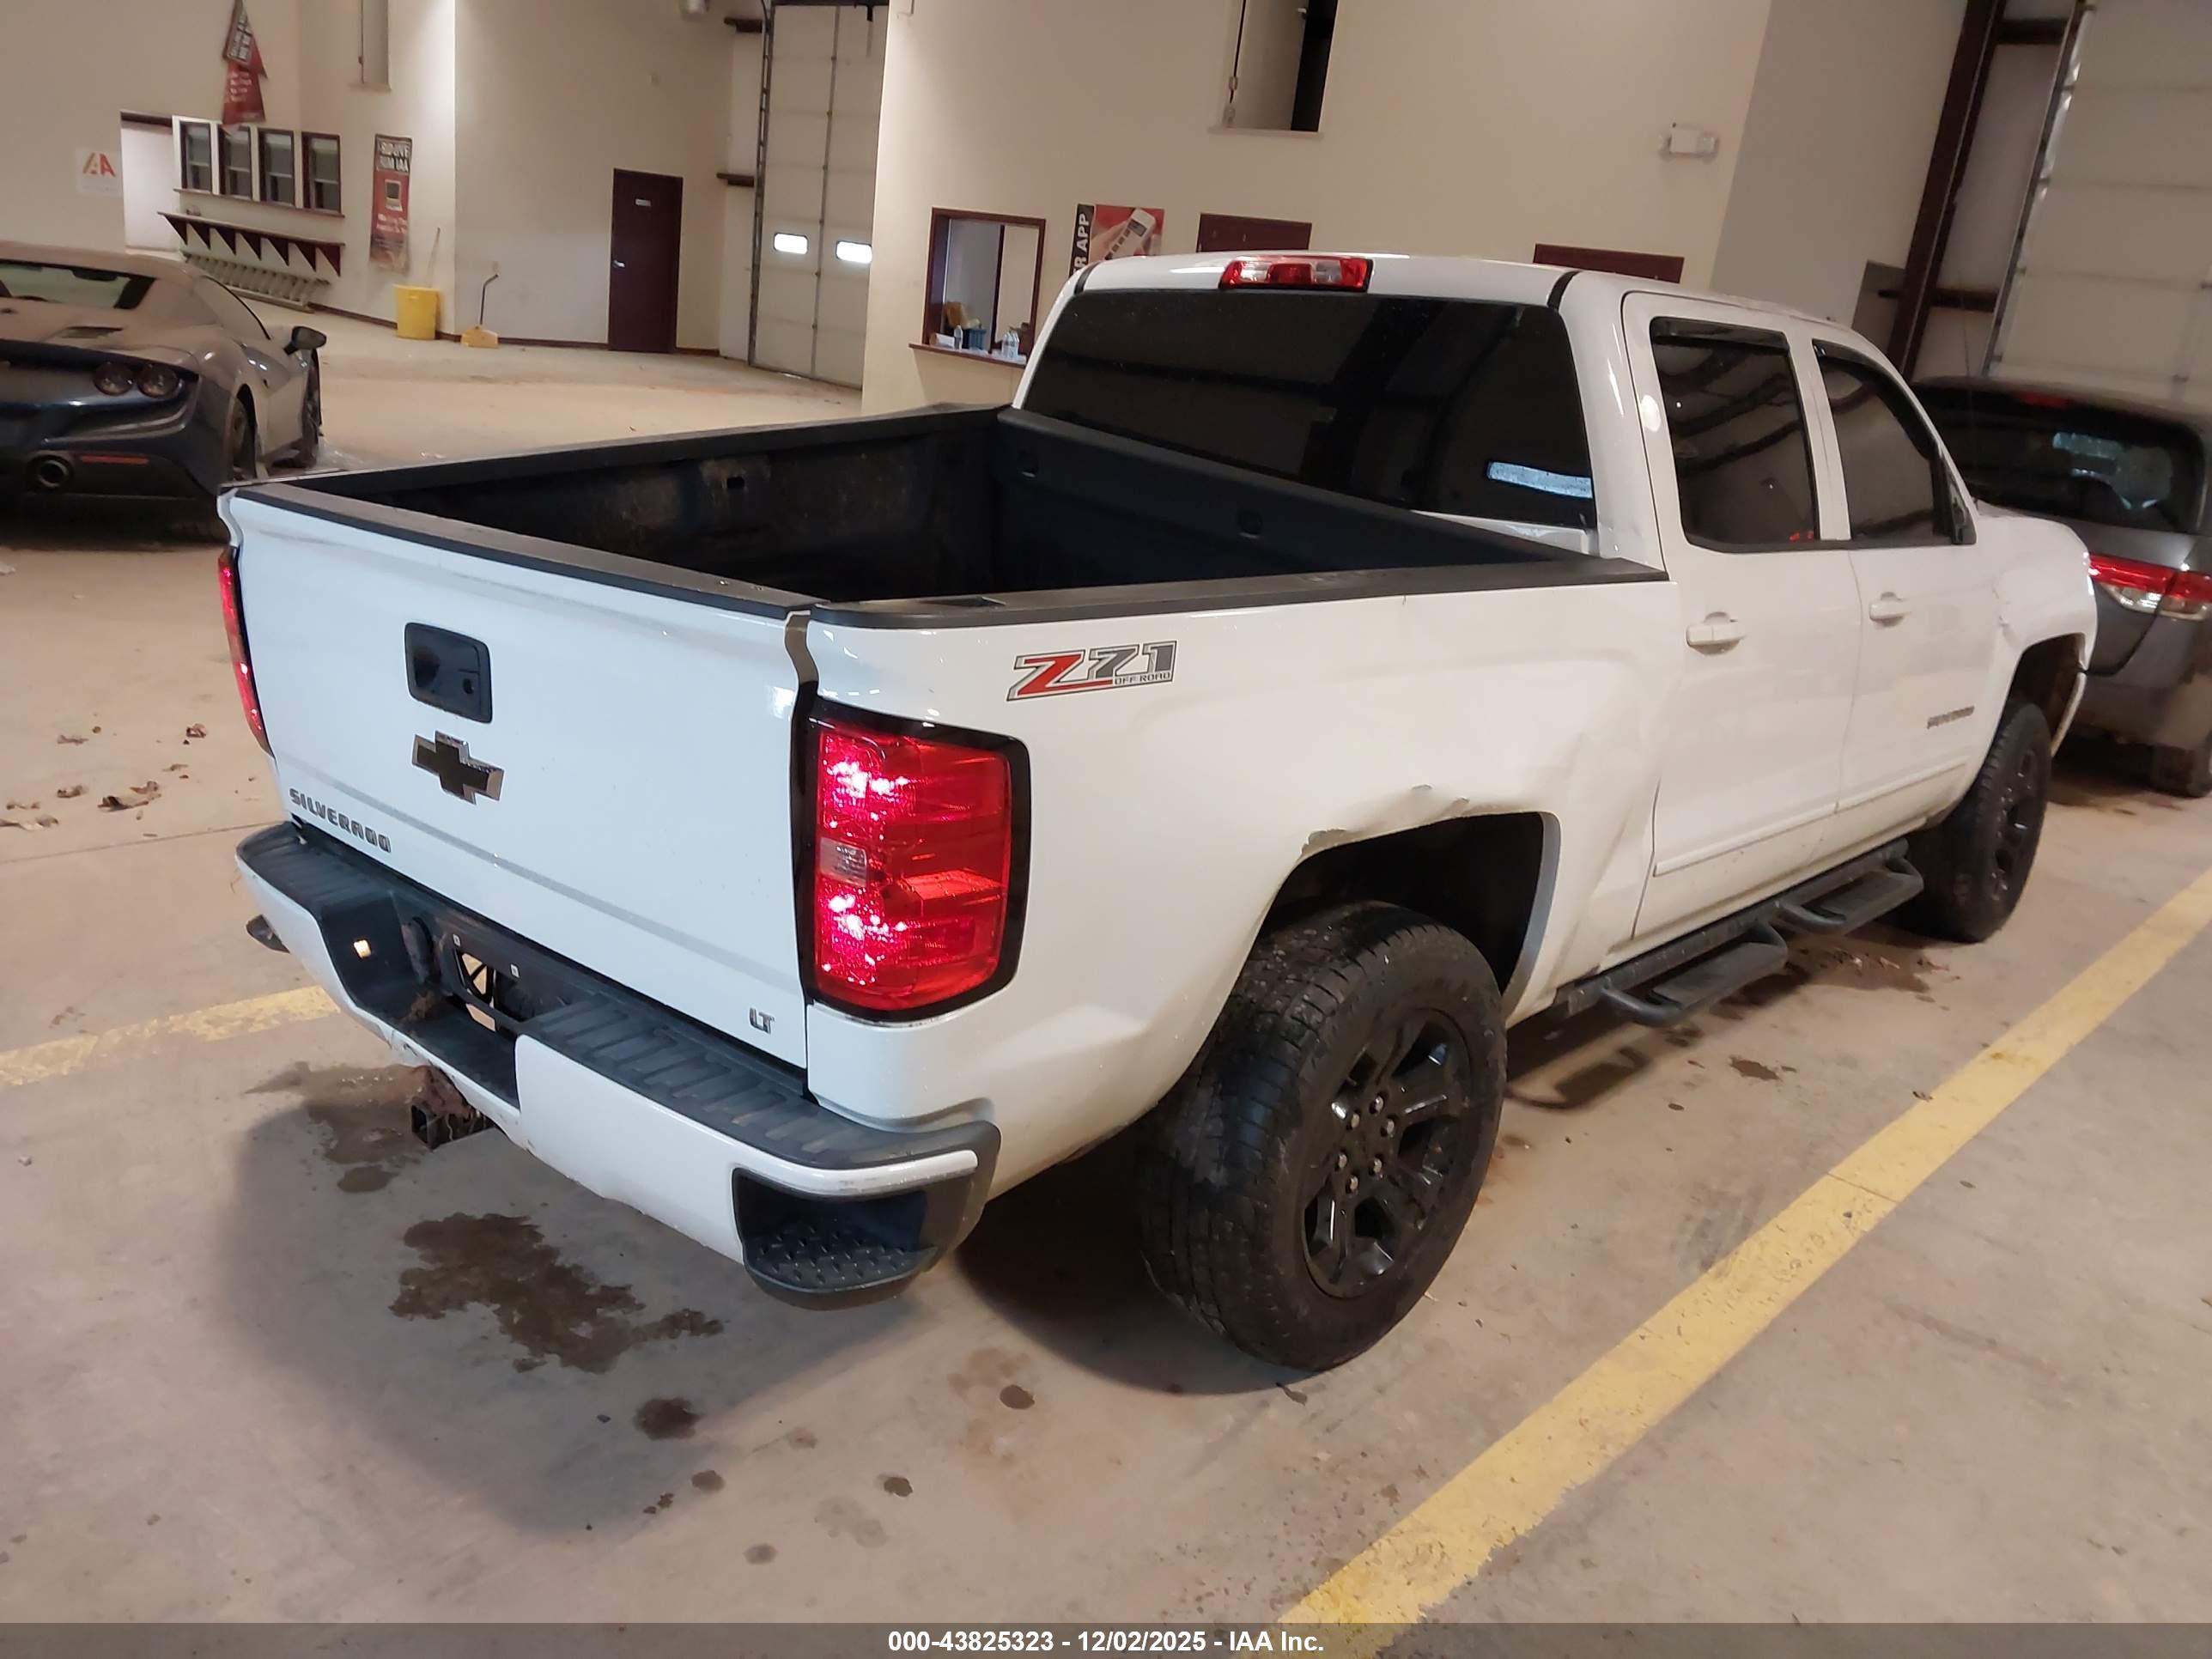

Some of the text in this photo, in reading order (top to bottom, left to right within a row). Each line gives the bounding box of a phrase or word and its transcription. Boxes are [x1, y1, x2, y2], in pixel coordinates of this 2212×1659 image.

[1077, 213, 1090, 252] APP
[1006, 640, 1177, 702] Z71
[1115, 672, 1171, 685] OFF ROAD
[289, 787, 392, 854] SILVERADO
[749, 1006, 775, 1035] LT
